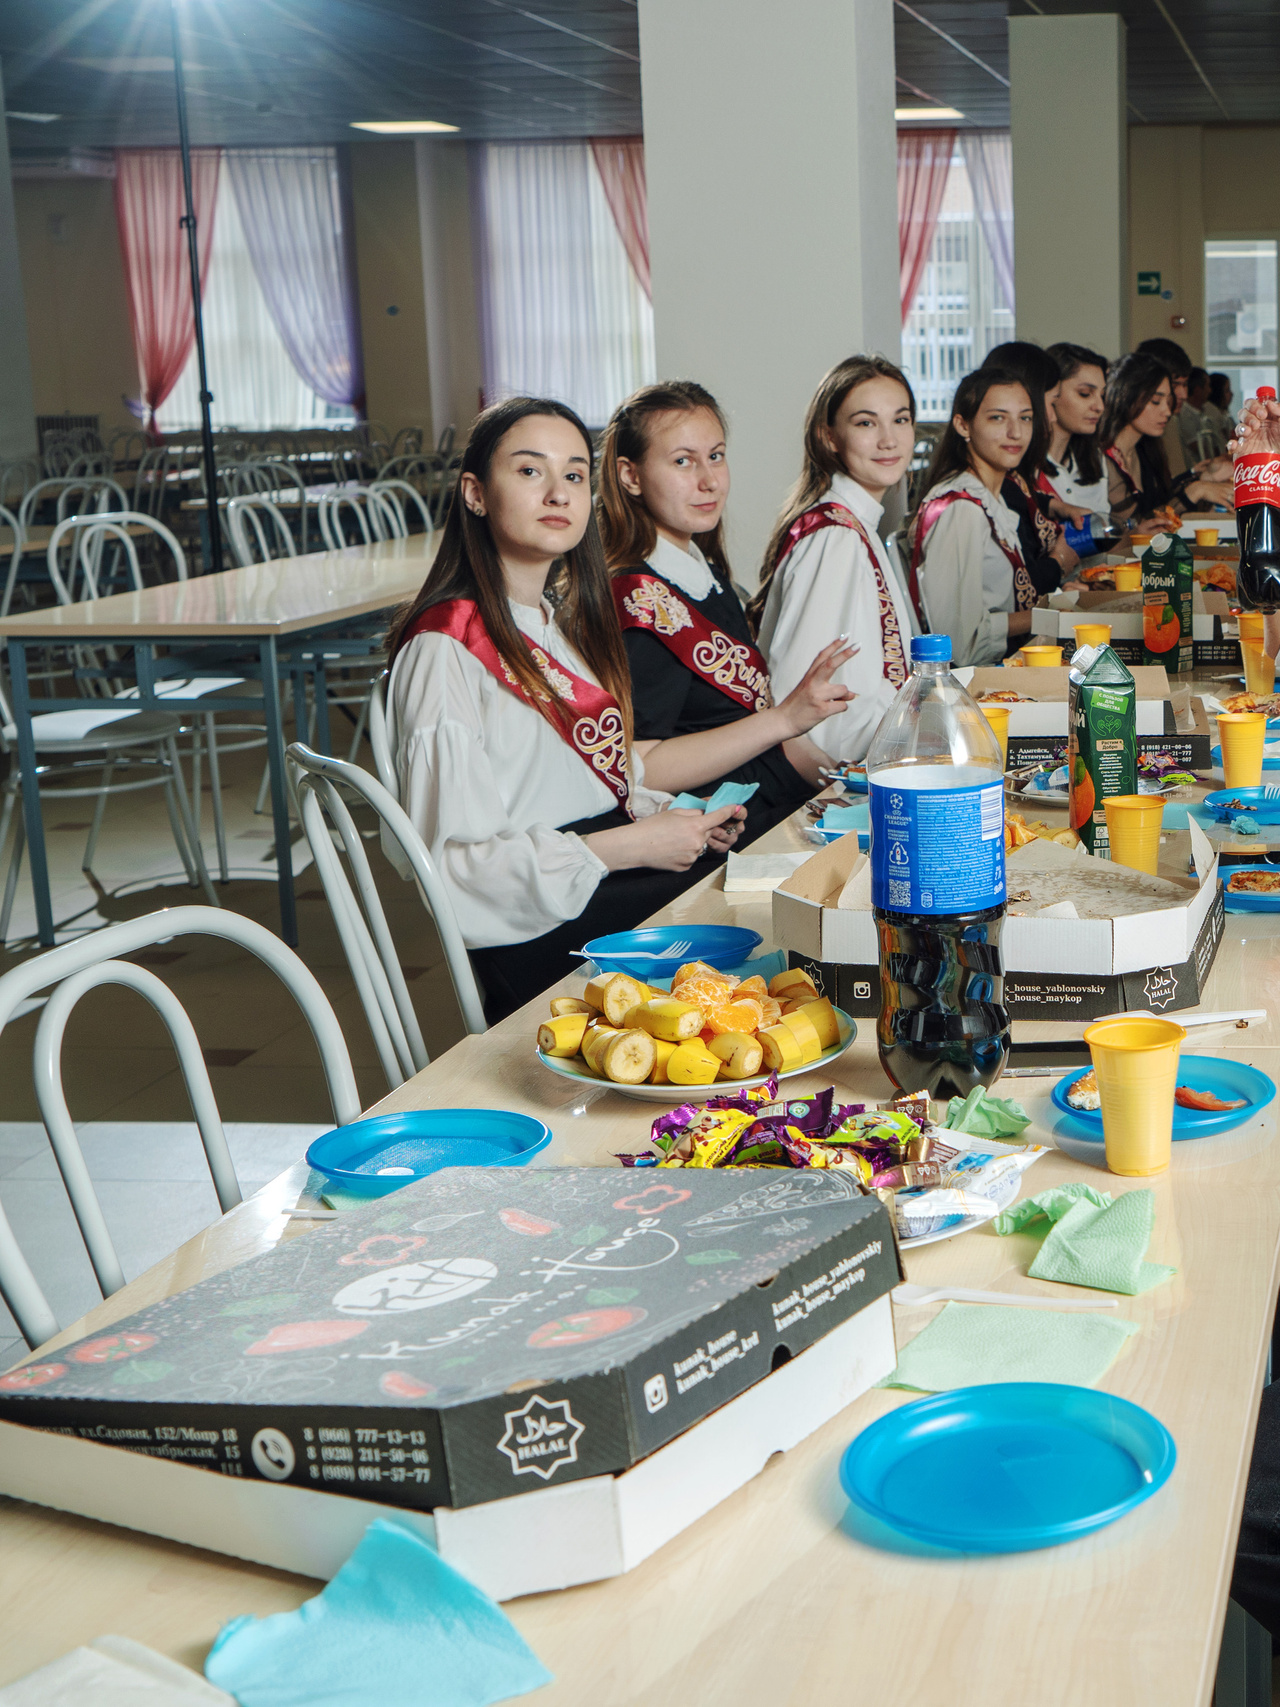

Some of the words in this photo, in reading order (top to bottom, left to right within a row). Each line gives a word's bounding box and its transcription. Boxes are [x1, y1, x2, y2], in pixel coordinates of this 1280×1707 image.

[1102, 693, 1124, 703] ПОЛЬЗОЙ
[1096, 702, 1121, 711] ОБЩЕСТВА
[884, 814, 912, 822] CHAMPIONS
[1004, 984, 1106, 994] k_house_yablonovskiy
[1151, 988, 1172, 999] HALAL
[1004, 994, 1082, 1004] k_house_maykop
[673, 1330, 737, 1378] kunak_house
[676, 1331, 760, 1395] kunak_house_krd
[222, 1428, 238, 1443] 18
[303, 1427, 315, 1442] 8
[355, 1428, 427, 1446] 777-13-13
[515, 1415, 568, 1445] حلال
[224, 1445, 241, 1460] 15
[306, 1445, 317, 1460] 8
[517, 1437, 568, 1461] HALAL
[309, 1464, 320, 1479] 8
